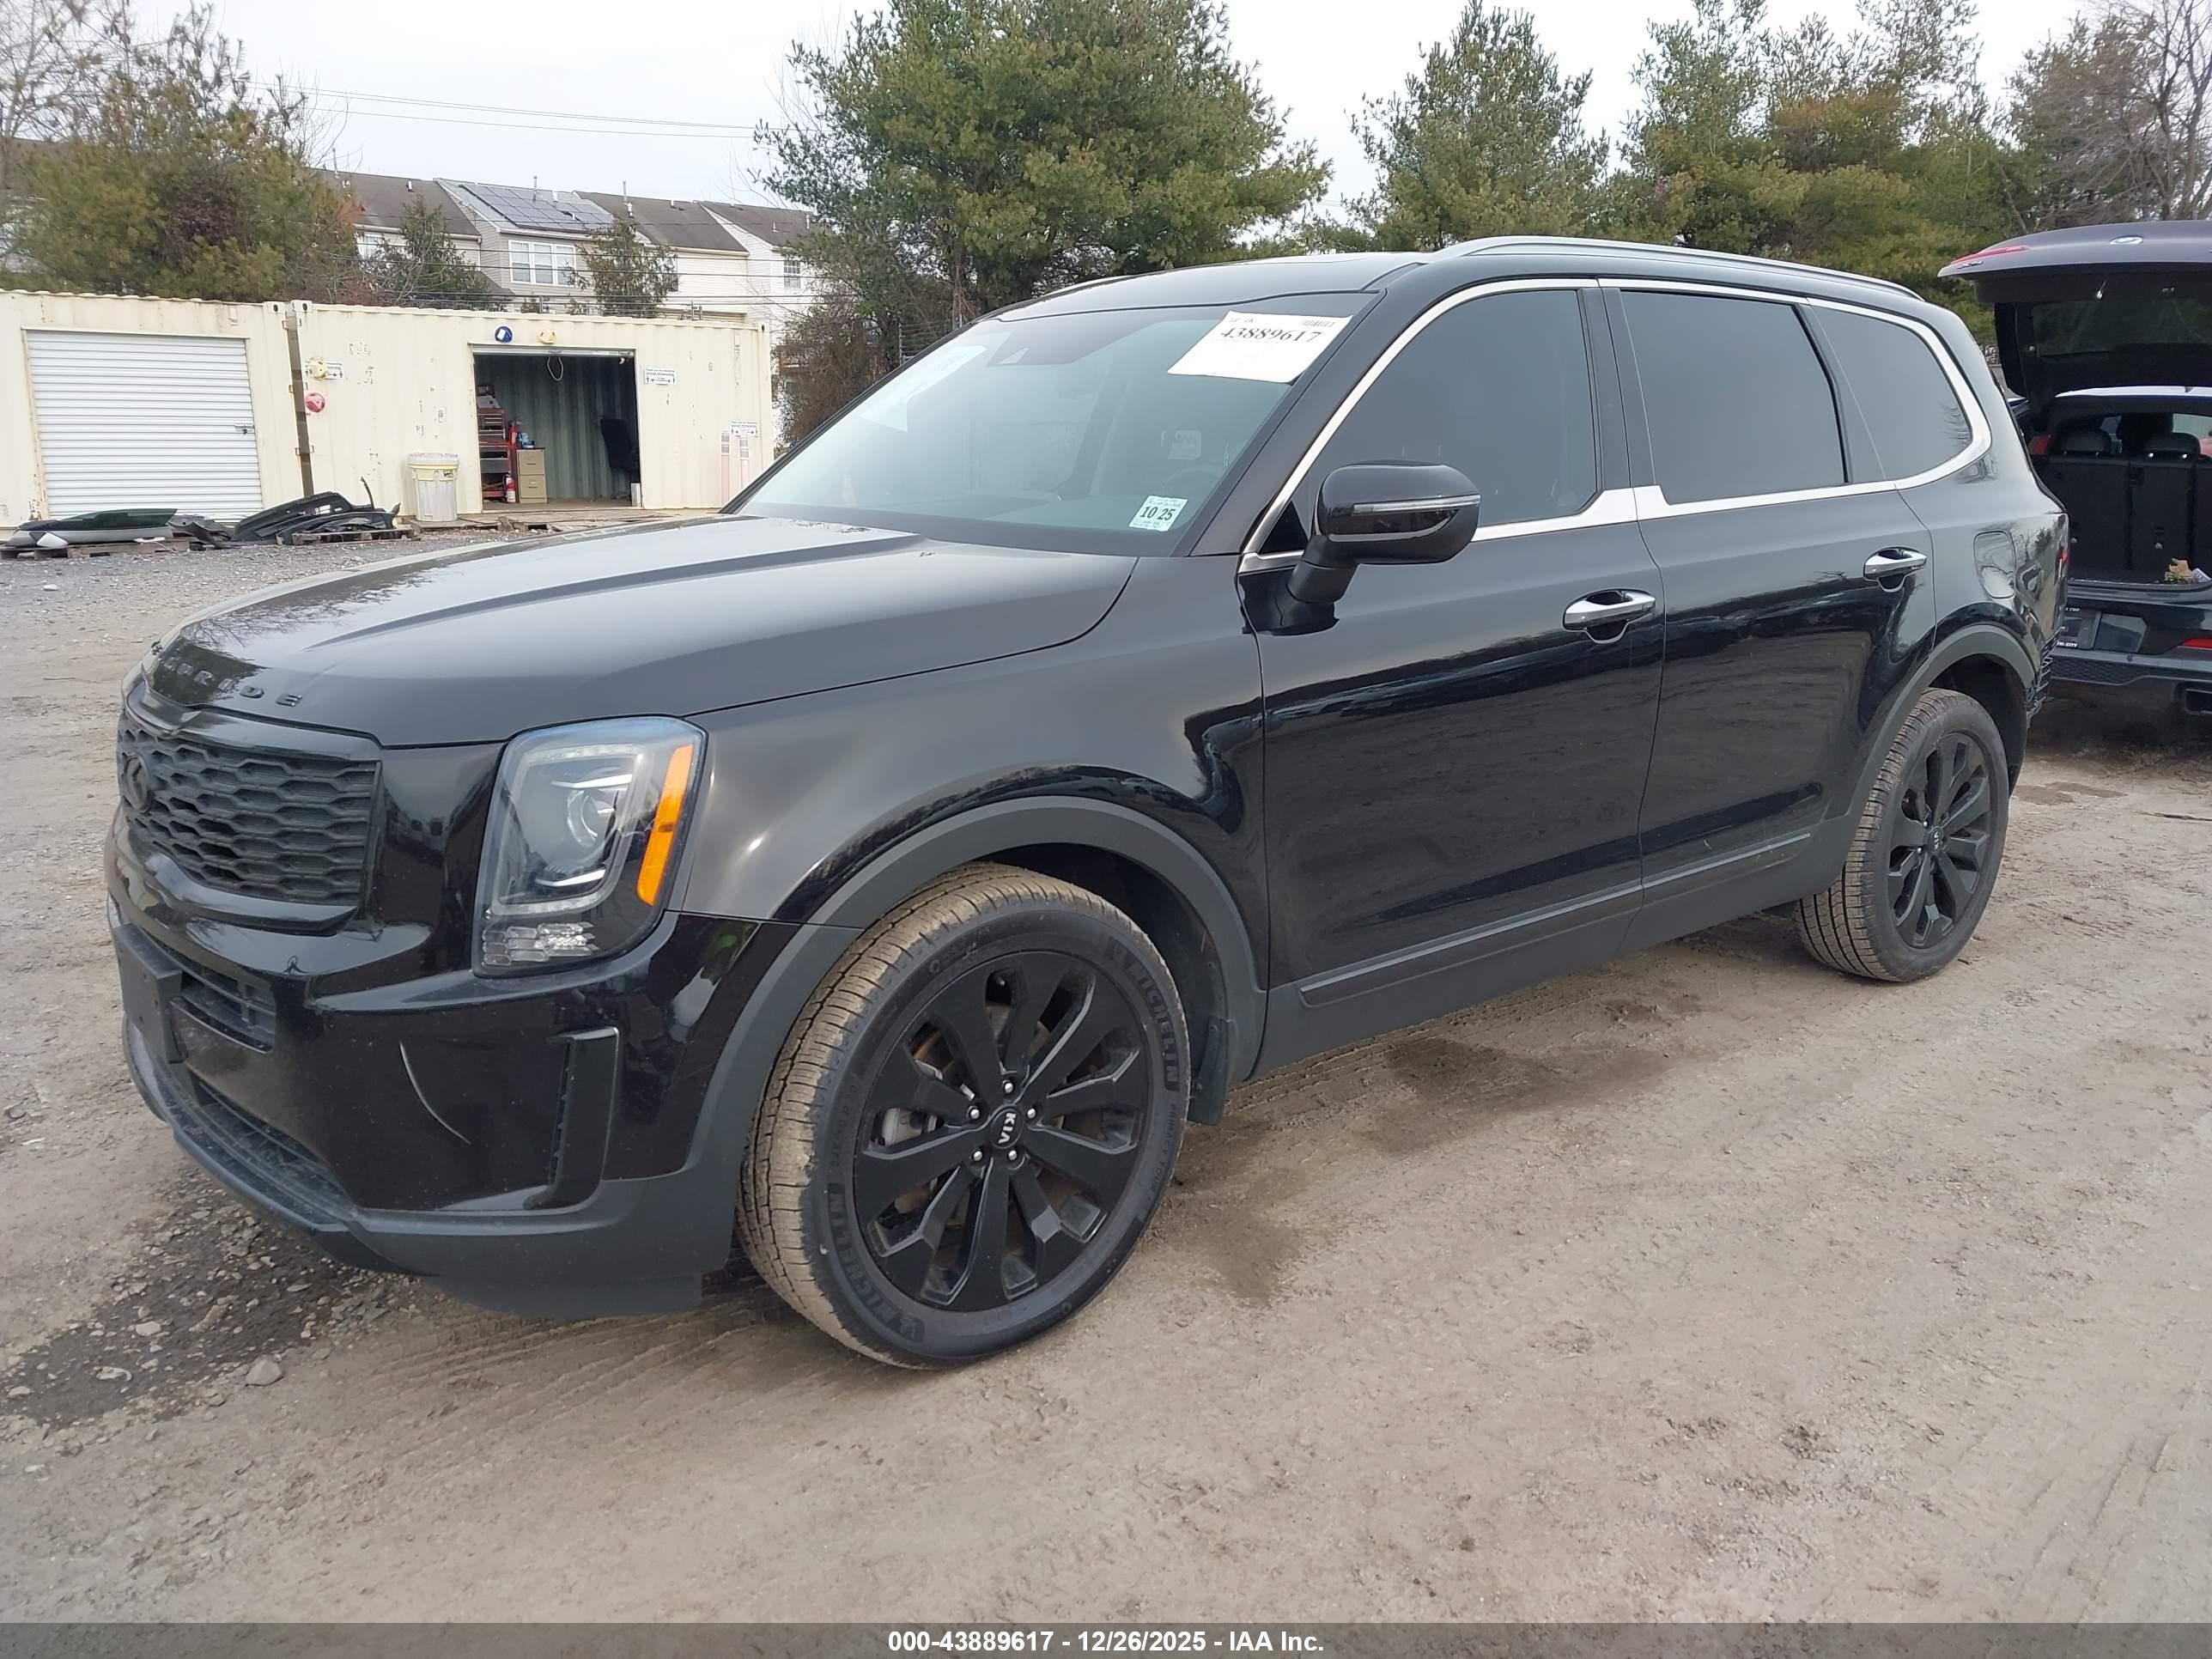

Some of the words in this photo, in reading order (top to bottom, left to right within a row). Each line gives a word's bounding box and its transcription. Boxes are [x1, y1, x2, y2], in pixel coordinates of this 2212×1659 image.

[1220, 326, 1322, 343] 43889617
[1139, 506, 1158, 519] 10
[1157, 507, 1176, 520] 25
[1127, 960, 1180, 1084] MICHELIN
[997, 1112, 1017, 1144] KIA
[829, 1192, 896, 1323] MICHELIN
